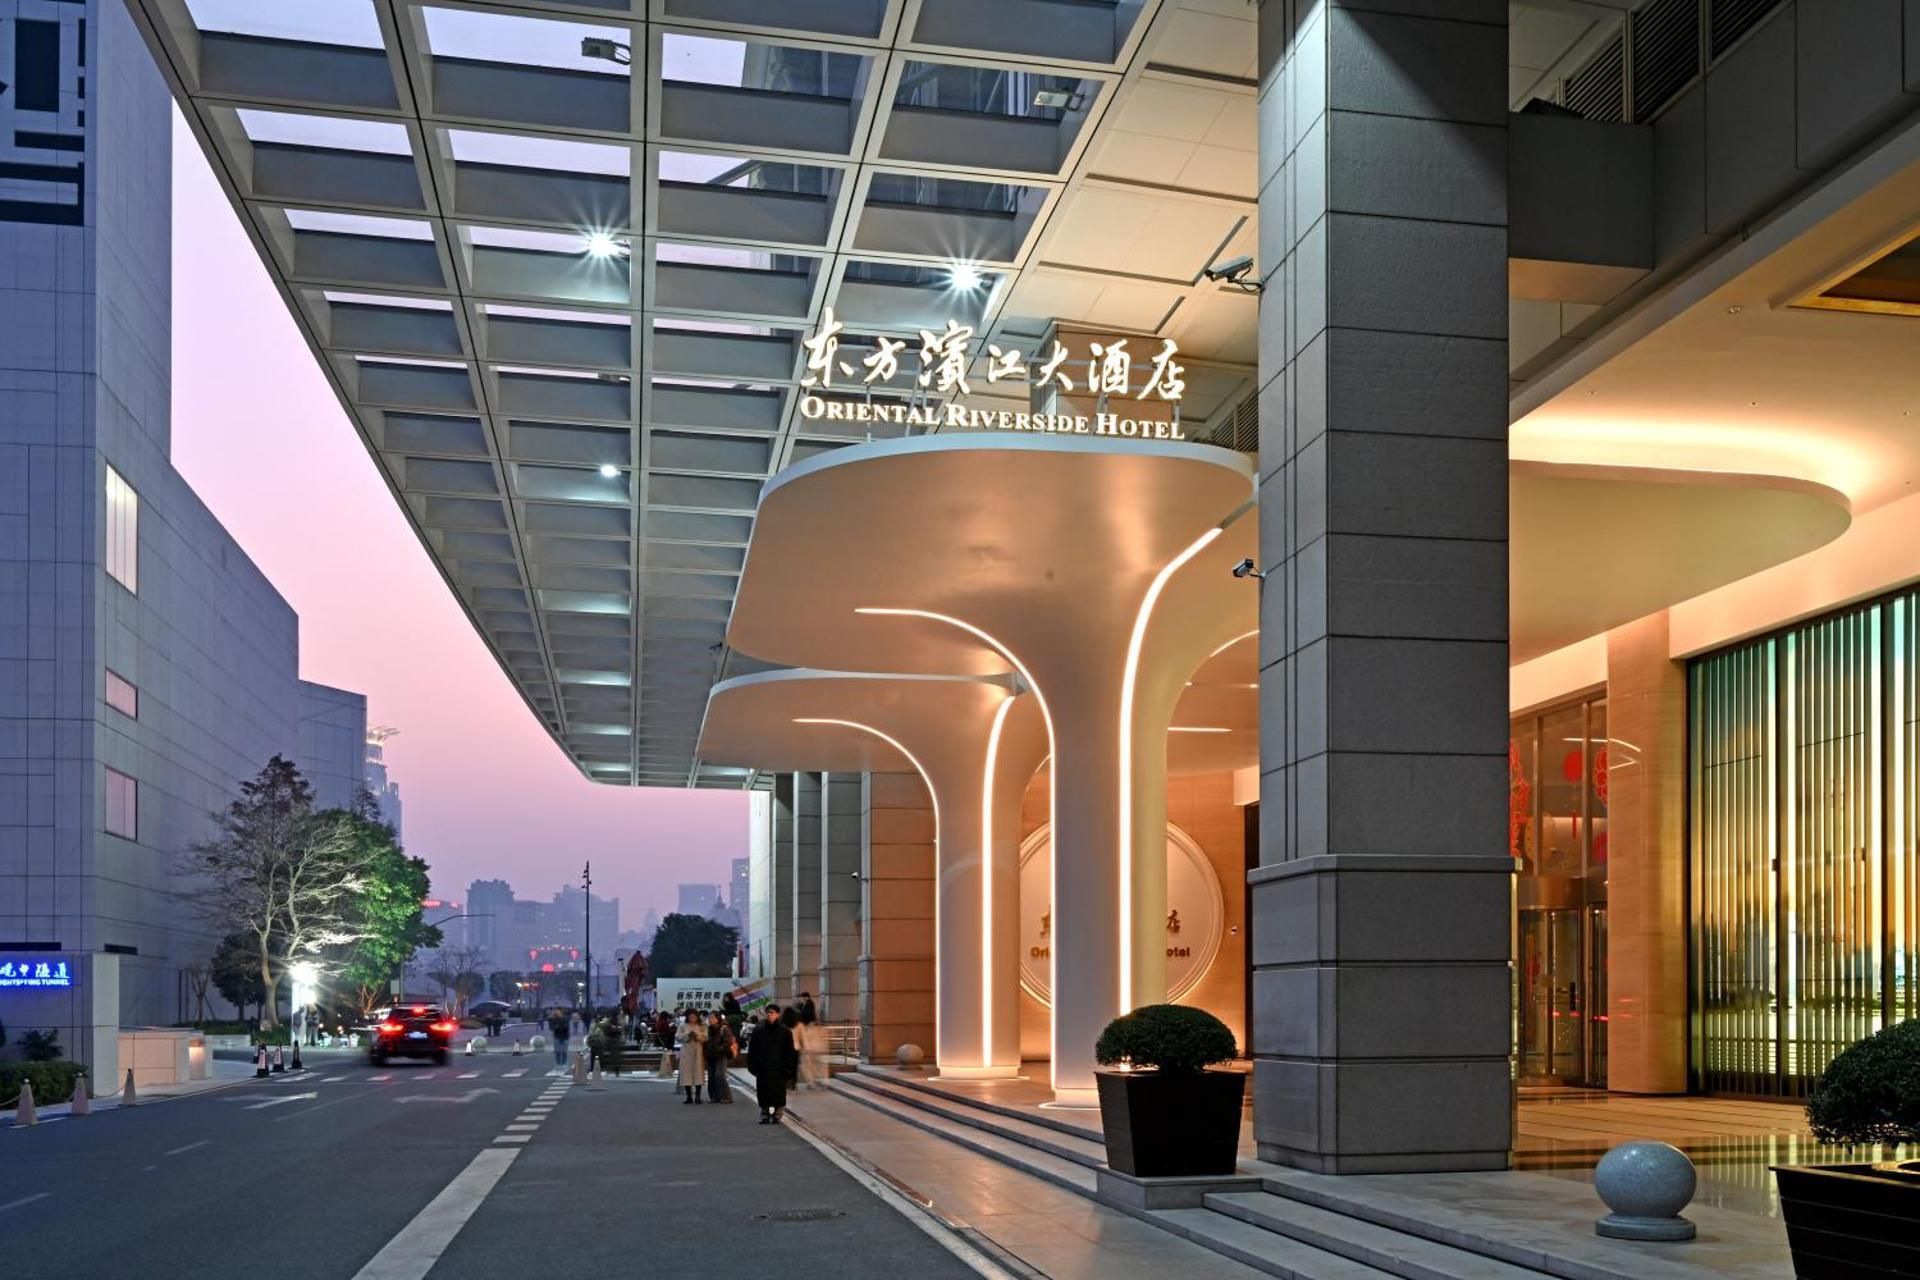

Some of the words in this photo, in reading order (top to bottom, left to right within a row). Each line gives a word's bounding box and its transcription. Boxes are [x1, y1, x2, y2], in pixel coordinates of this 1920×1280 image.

[800, 395, 941, 426] ORIENTAL
[946, 402, 1090, 434] RIVERSIDE
[1095, 411, 1186, 441] HOTEL
[1166, 946, 1191, 957] otel
